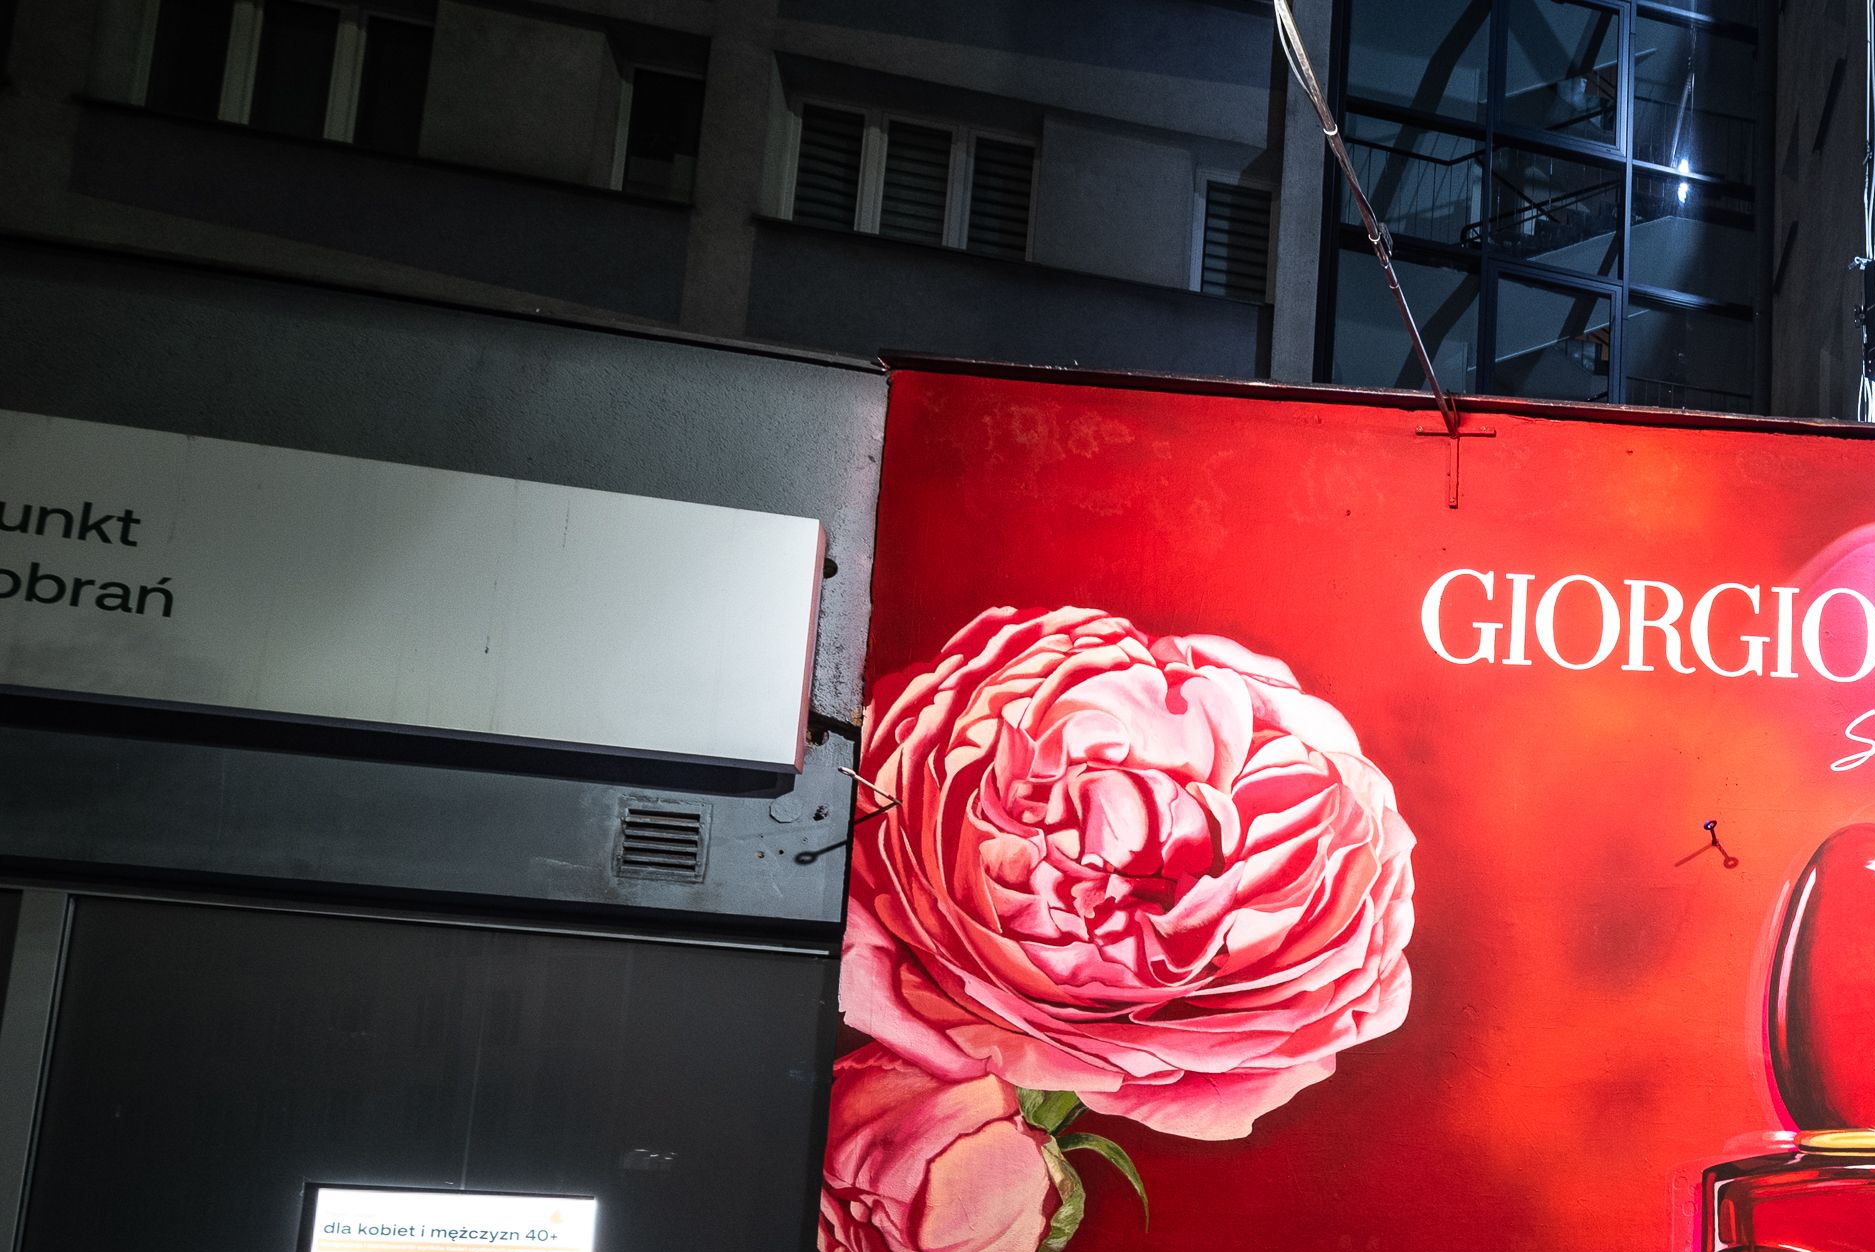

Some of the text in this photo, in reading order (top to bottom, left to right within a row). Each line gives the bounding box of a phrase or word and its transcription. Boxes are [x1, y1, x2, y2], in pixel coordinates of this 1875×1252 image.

[0, 501, 141, 547] unkt
[0, 562, 174, 618] obrań
[323, 1222, 559, 1243] dla kobiet i mężczyzn 40+
